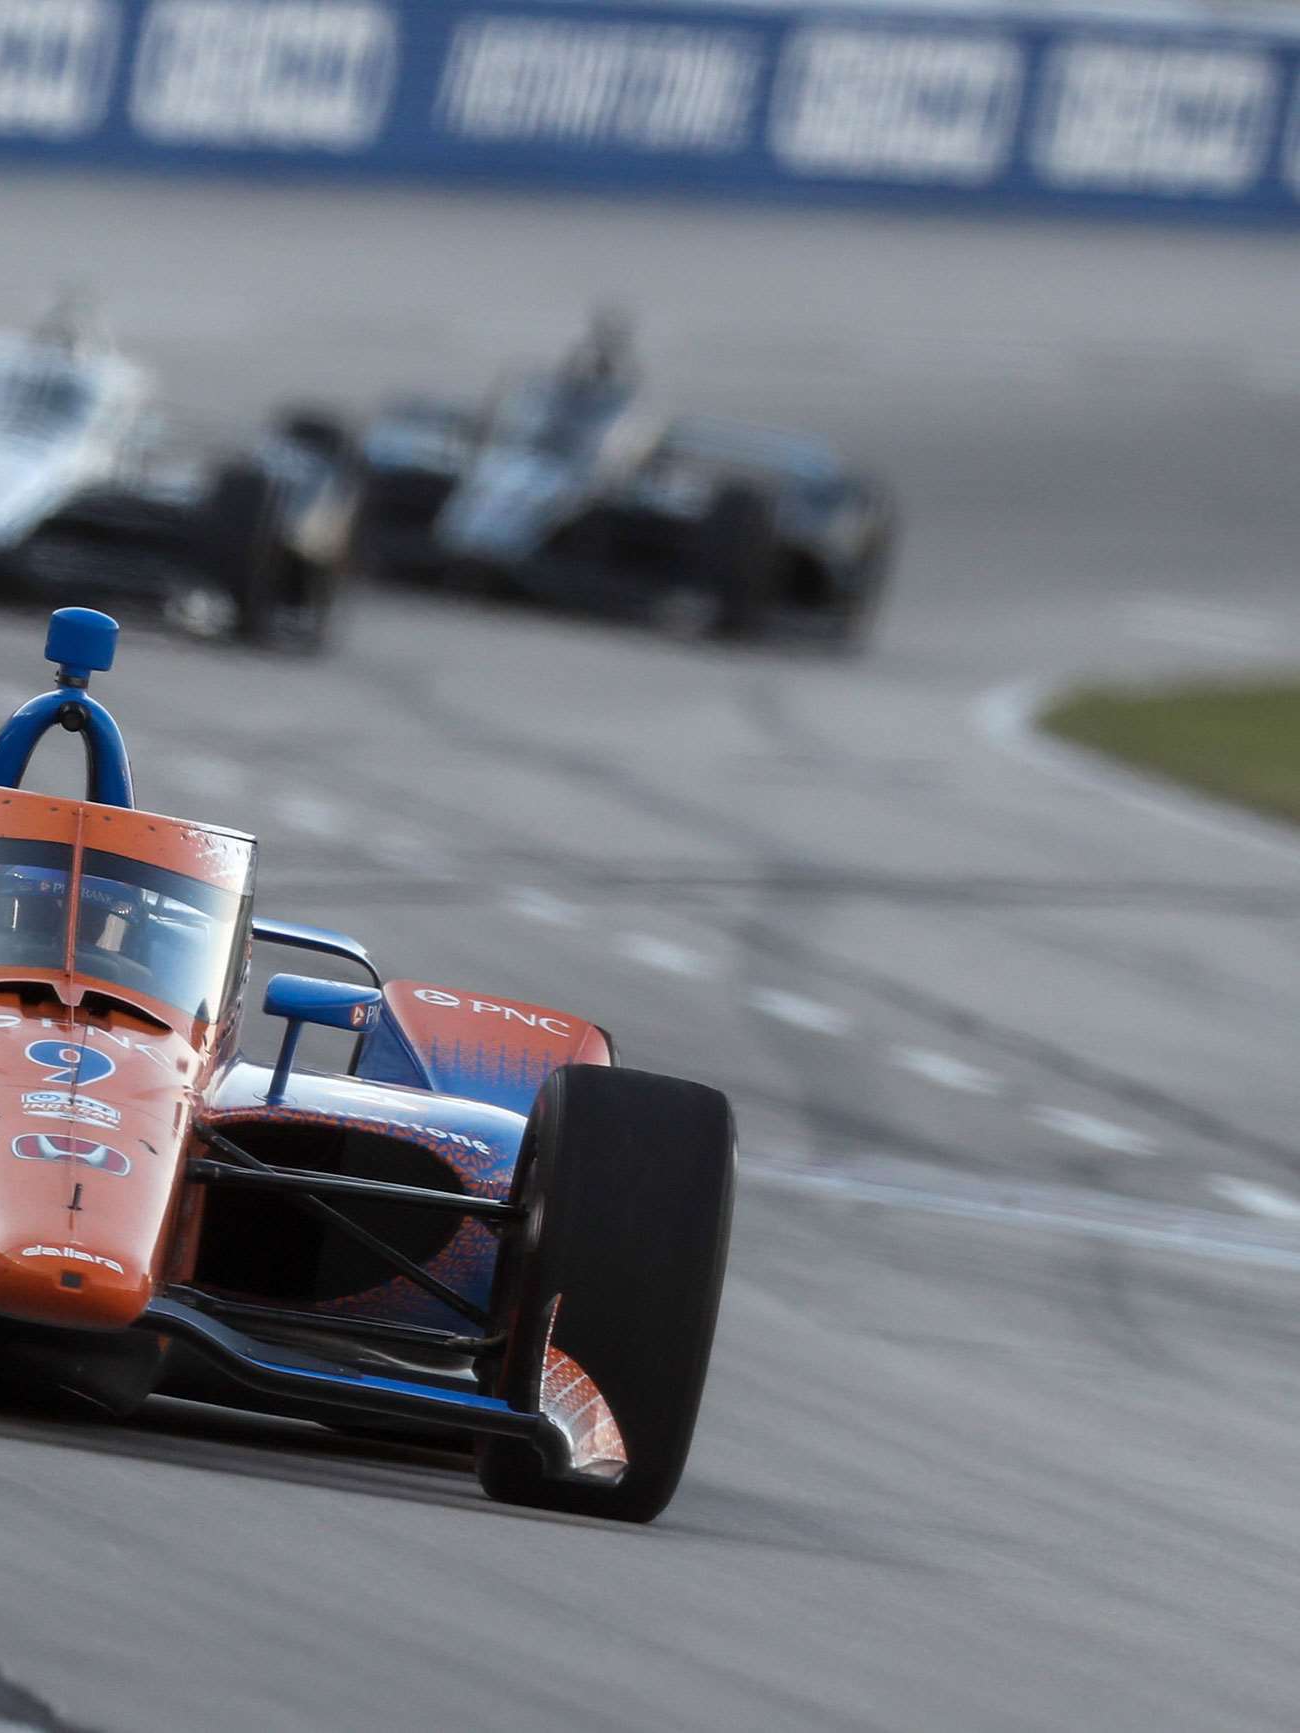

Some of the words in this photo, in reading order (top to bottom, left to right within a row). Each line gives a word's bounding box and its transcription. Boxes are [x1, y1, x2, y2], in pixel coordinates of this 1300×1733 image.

[468, 999, 571, 1038] PNC
[24, 1039, 117, 1087] 9
[42, 1017, 176, 1077] NC
[21, 1244, 125, 1275] dallara
